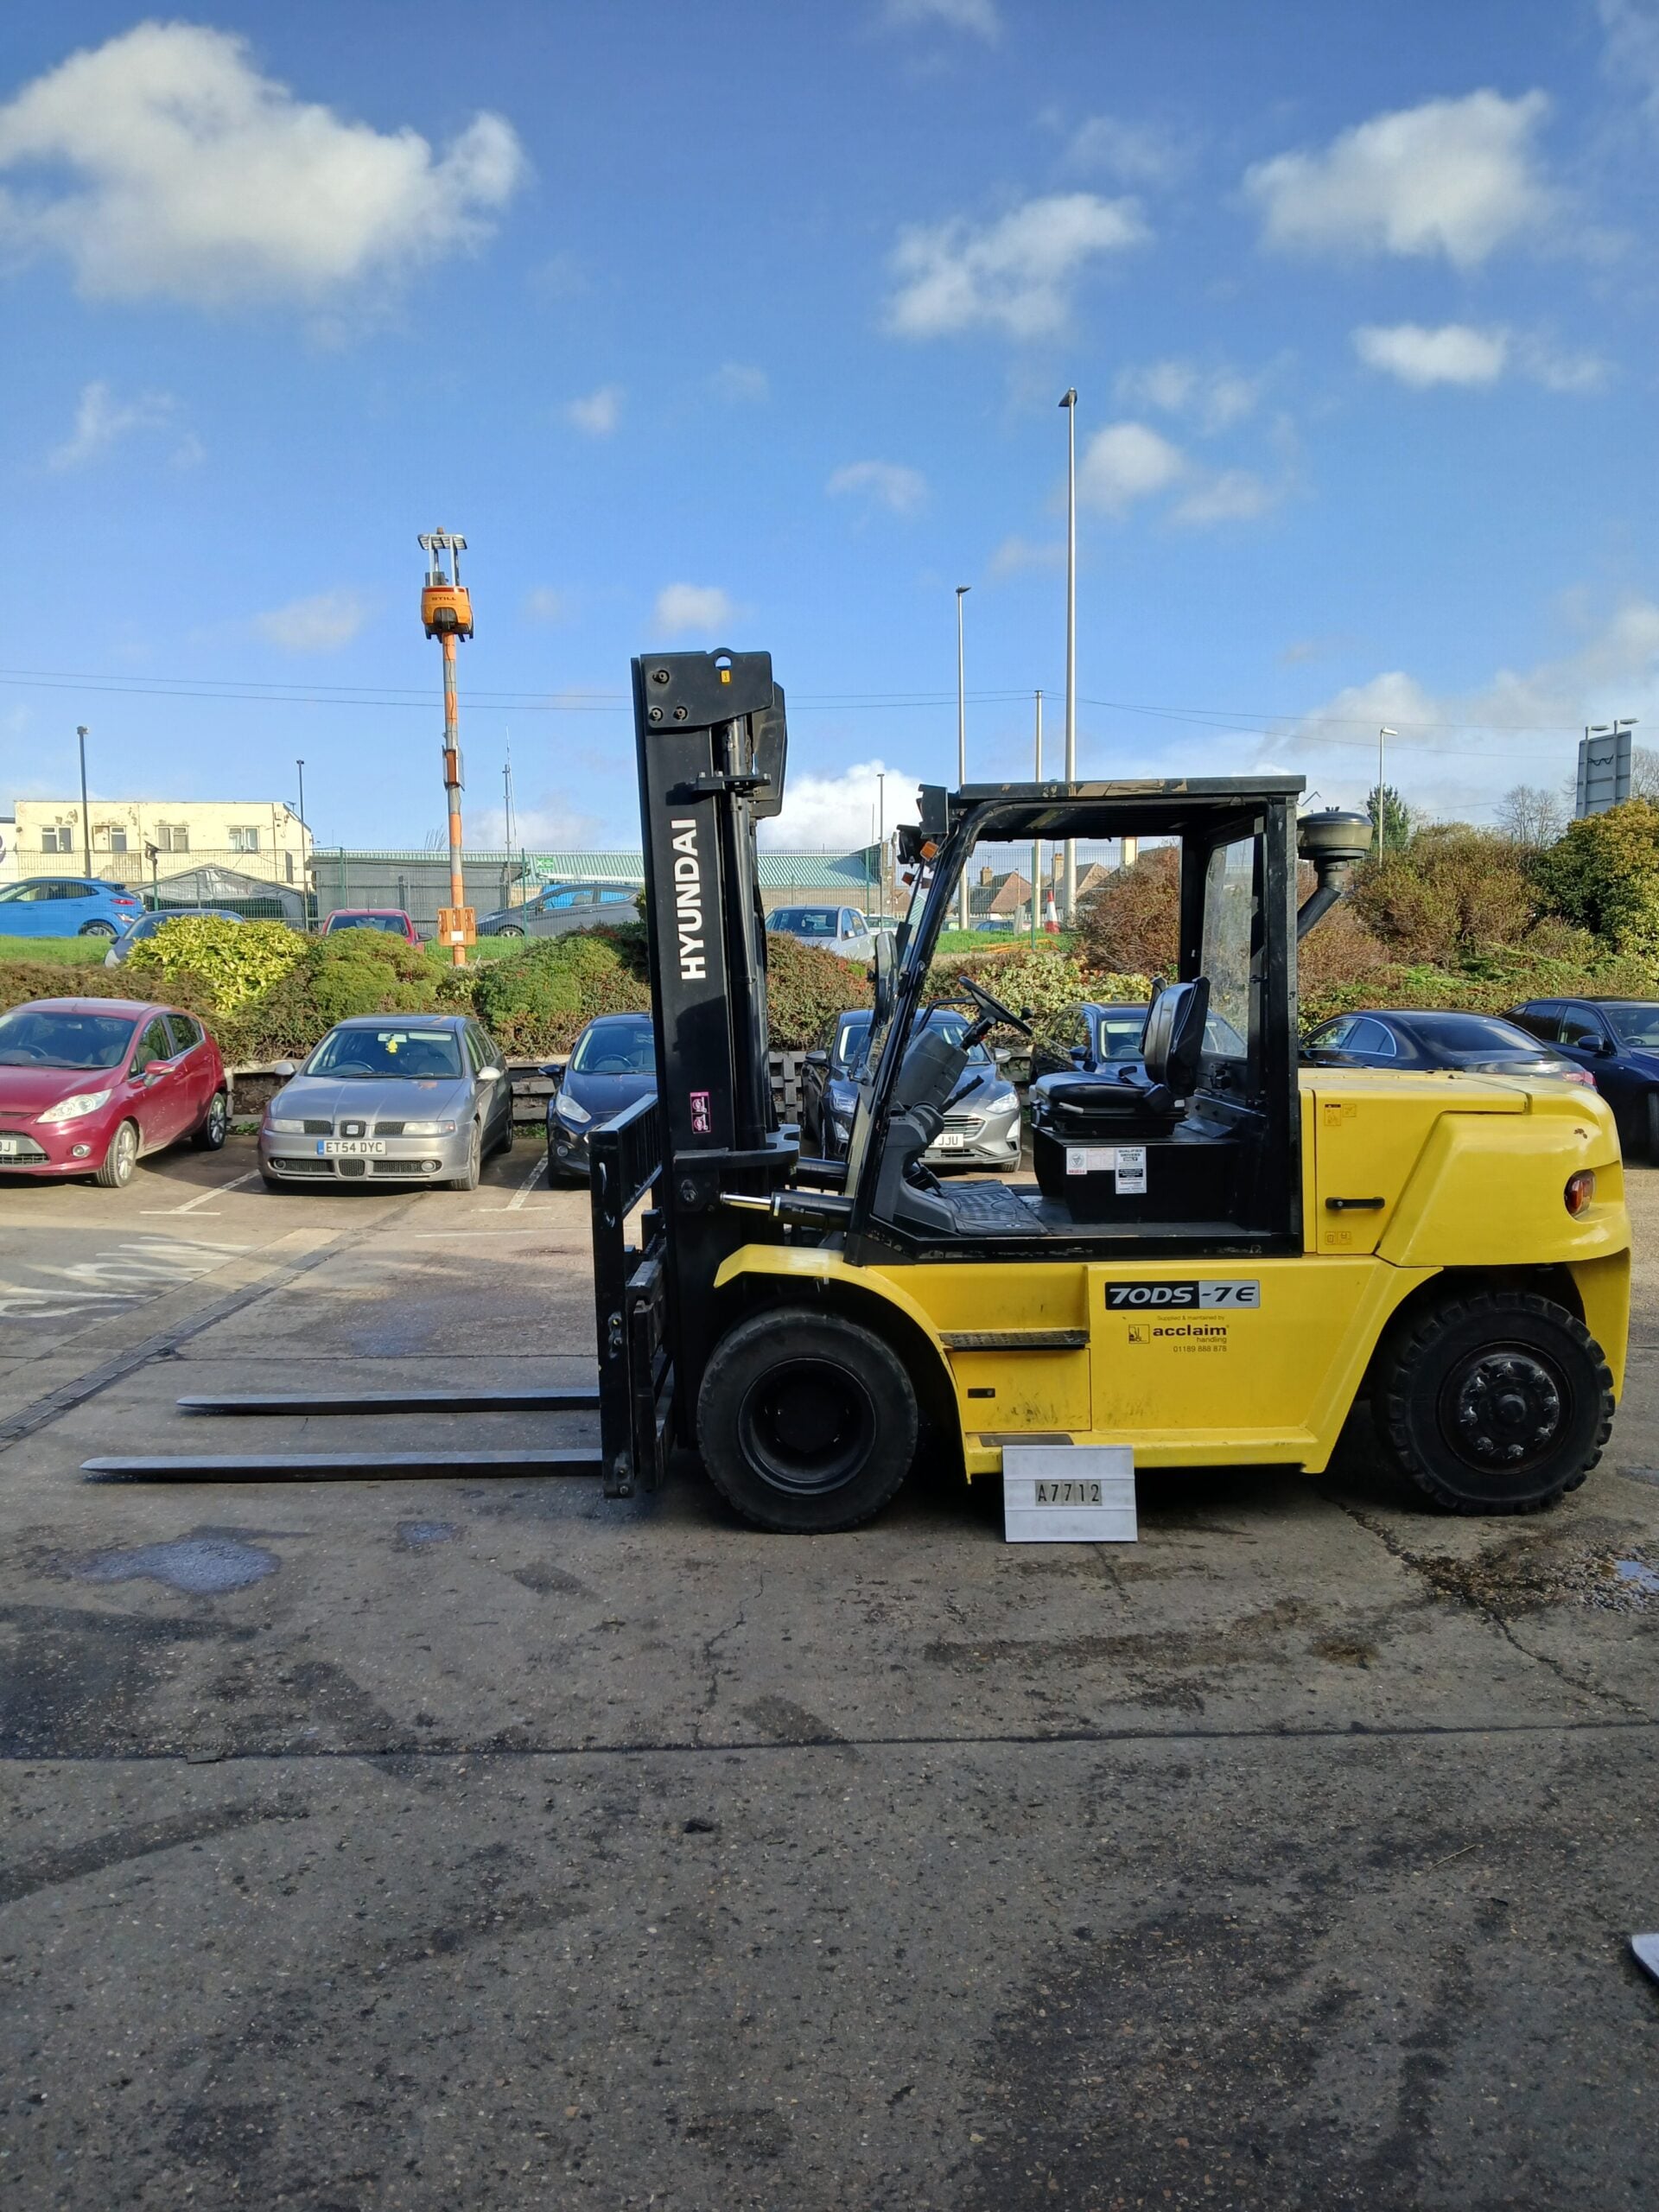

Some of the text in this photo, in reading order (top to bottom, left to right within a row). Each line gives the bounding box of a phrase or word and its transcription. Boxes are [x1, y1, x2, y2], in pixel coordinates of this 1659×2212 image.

[671, 819, 706, 980] HYUNDAI
[326, 1142, 383, 1153] ET54 DYC
[1153, 1325, 1227, 1336] acclaim
[1038, 1484, 1099, 1502] A7712
